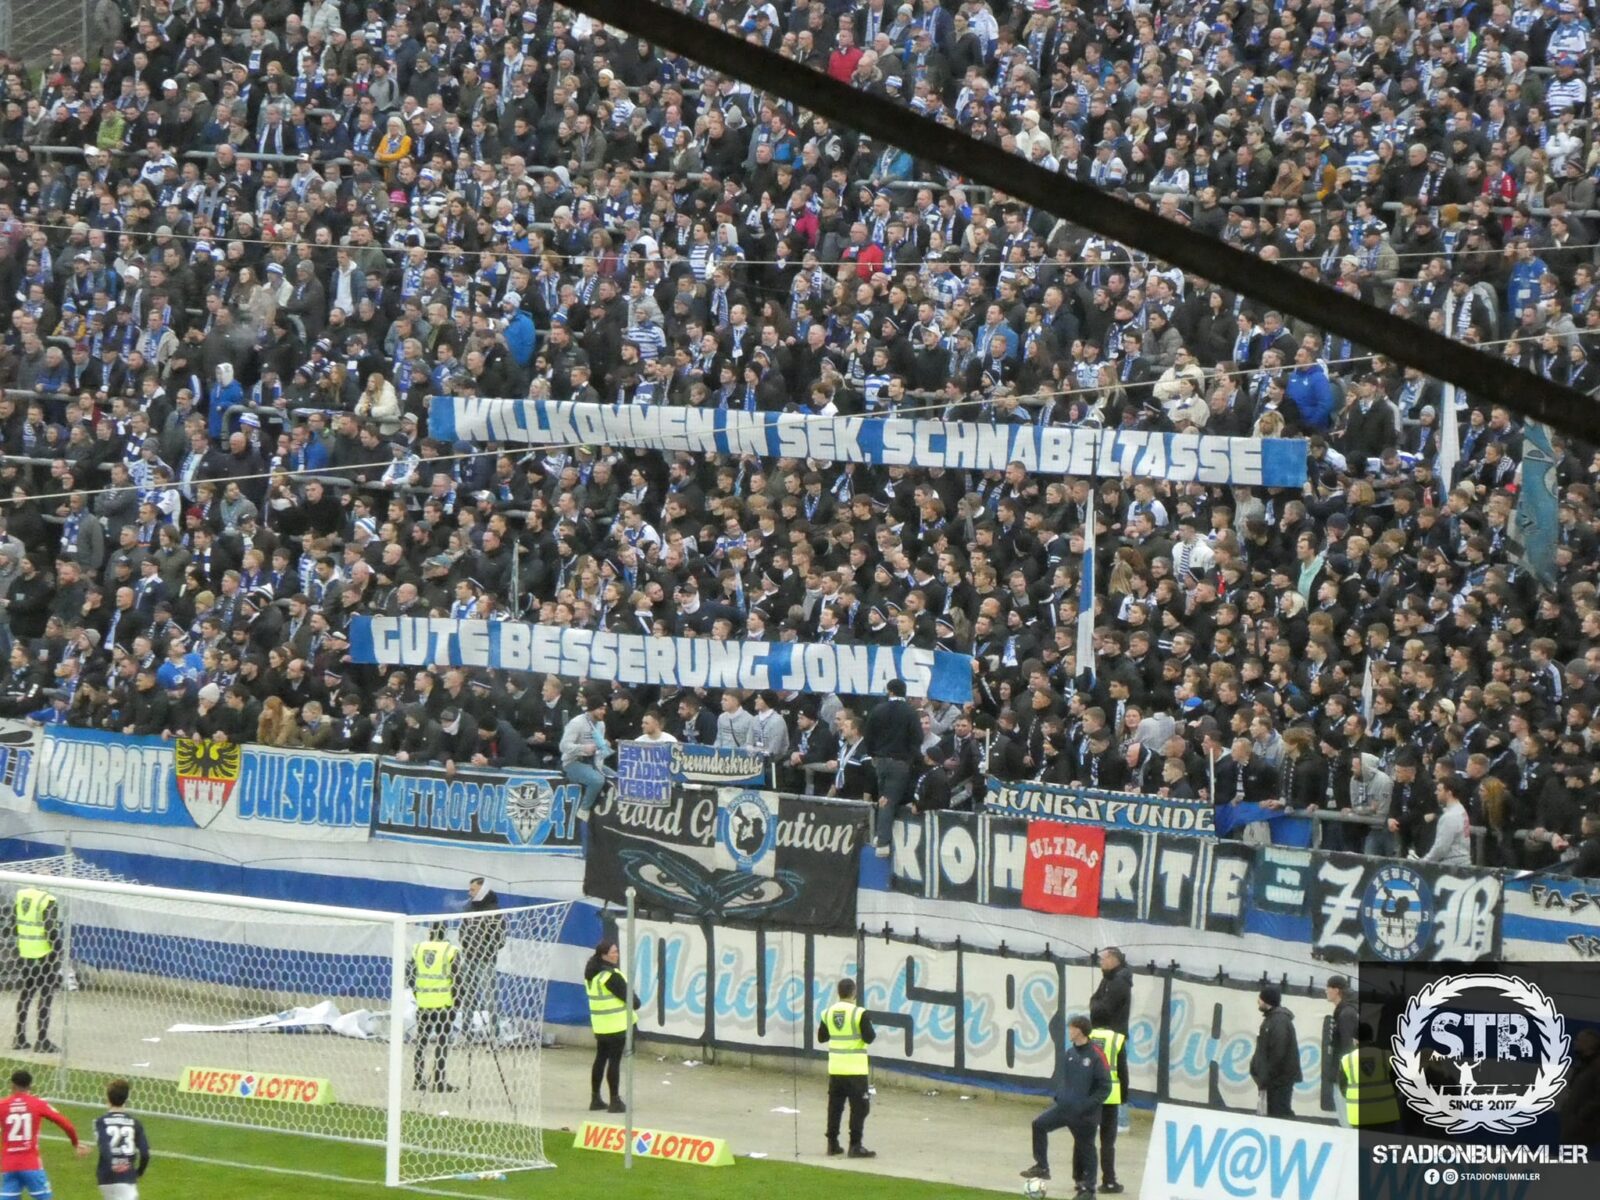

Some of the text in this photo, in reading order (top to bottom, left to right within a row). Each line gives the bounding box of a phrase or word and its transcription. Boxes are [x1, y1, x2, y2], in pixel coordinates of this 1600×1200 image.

[454, 397, 1263, 484] WILLKOMMEN IN SEK. SCHNABELTASSE
[371, 615, 935, 699] GUTE BESSERUNG JONAS
[669, 743, 764, 775] Freundeskreis
[239, 752, 374, 828] DUISBURG
[379, 772, 582, 840] METROPOL 47
[690, 798, 855, 856] Gation
[893, 820, 1249, 917] KOHRTE
[1029, 836, 1099, 869] ULTRAS
[1043, 864, 1078, 898] MZ
[188, 1069, 319, 1103] WEST LOTTO
[5, 1112, 32, 1142] 21
[106, 1125, 136, 1156] 23
[650, 1132, 715, 1163] LOTTO
